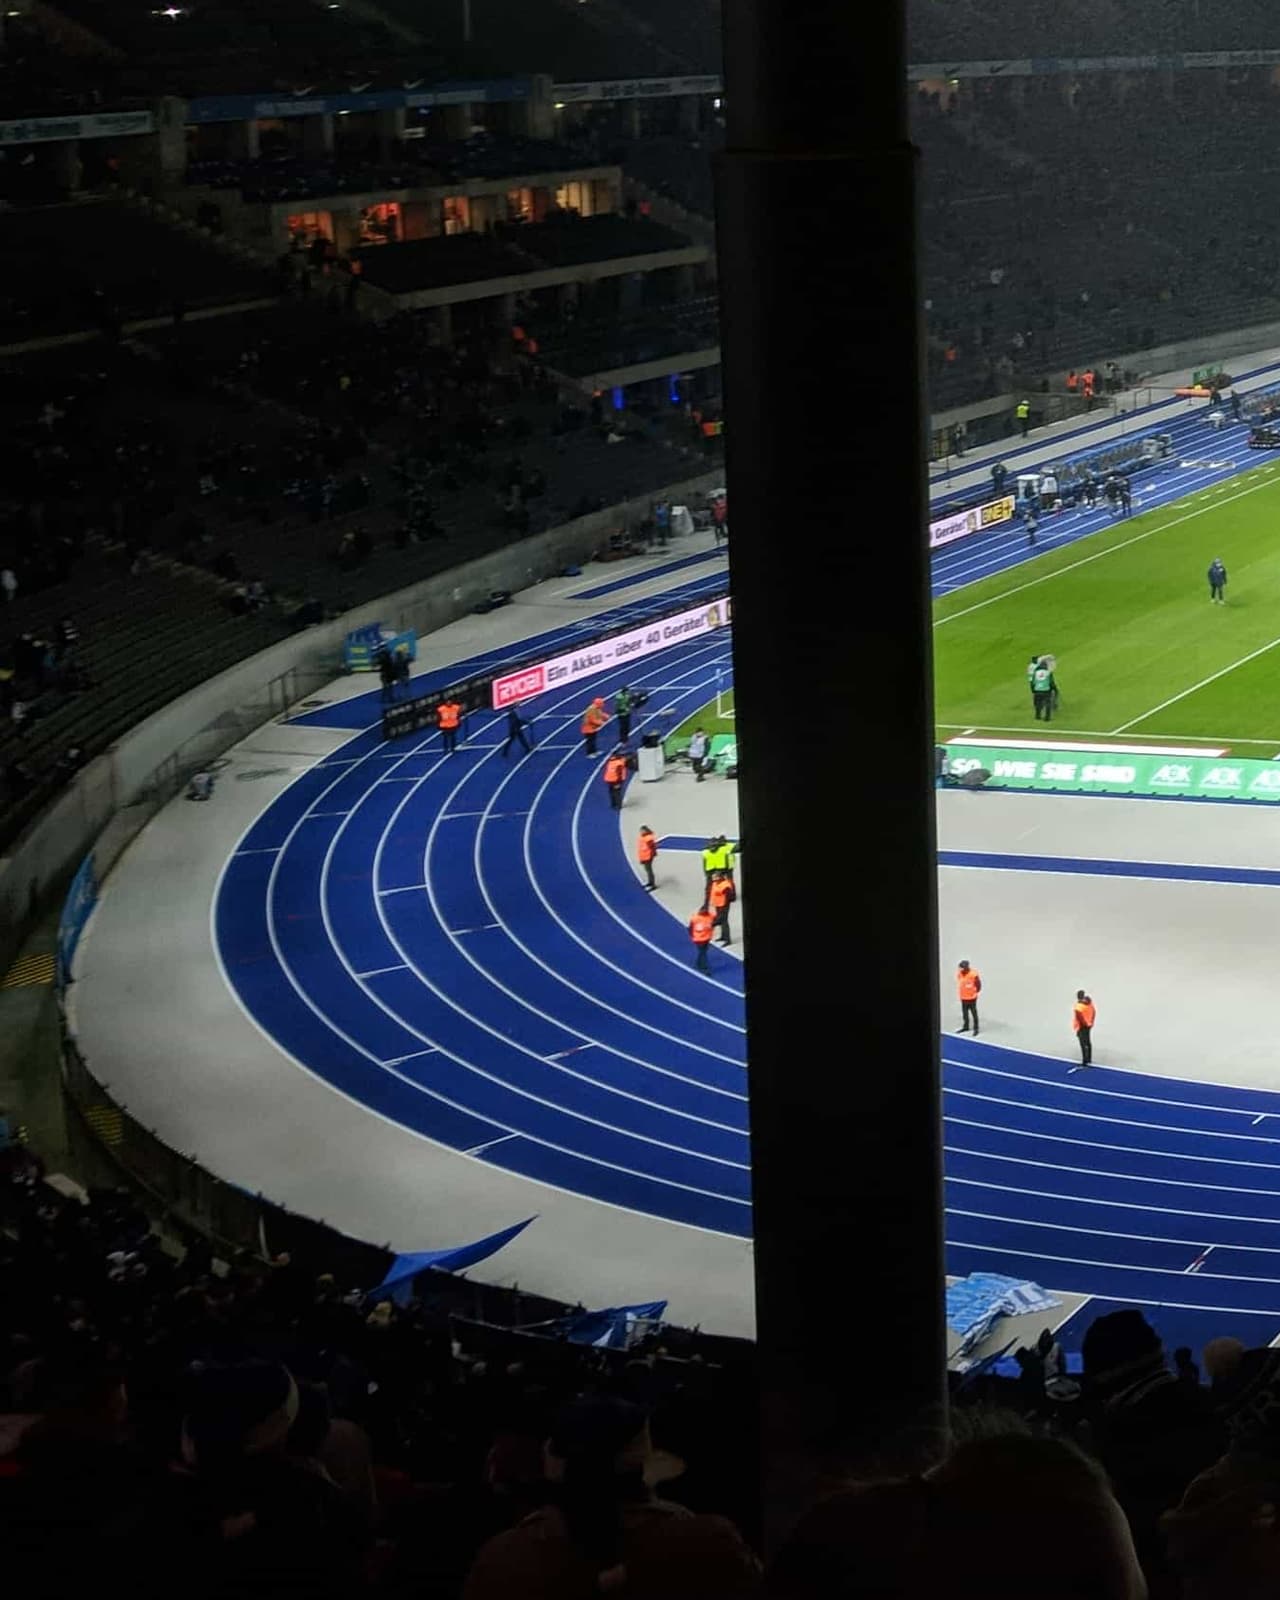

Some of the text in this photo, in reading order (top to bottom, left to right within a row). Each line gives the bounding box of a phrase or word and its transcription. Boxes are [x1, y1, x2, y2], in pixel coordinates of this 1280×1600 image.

[498, 669, 543, 700] RYOBI
[547, 666, 568, 683] Ein
[571, 654, 603, 673] Akku
[615, 640, 644, 658] über
[646, 630, 661, 645] 40
[993, 760, 1036, 779] WIE
[1040, 762, 1078, 781] SIE
